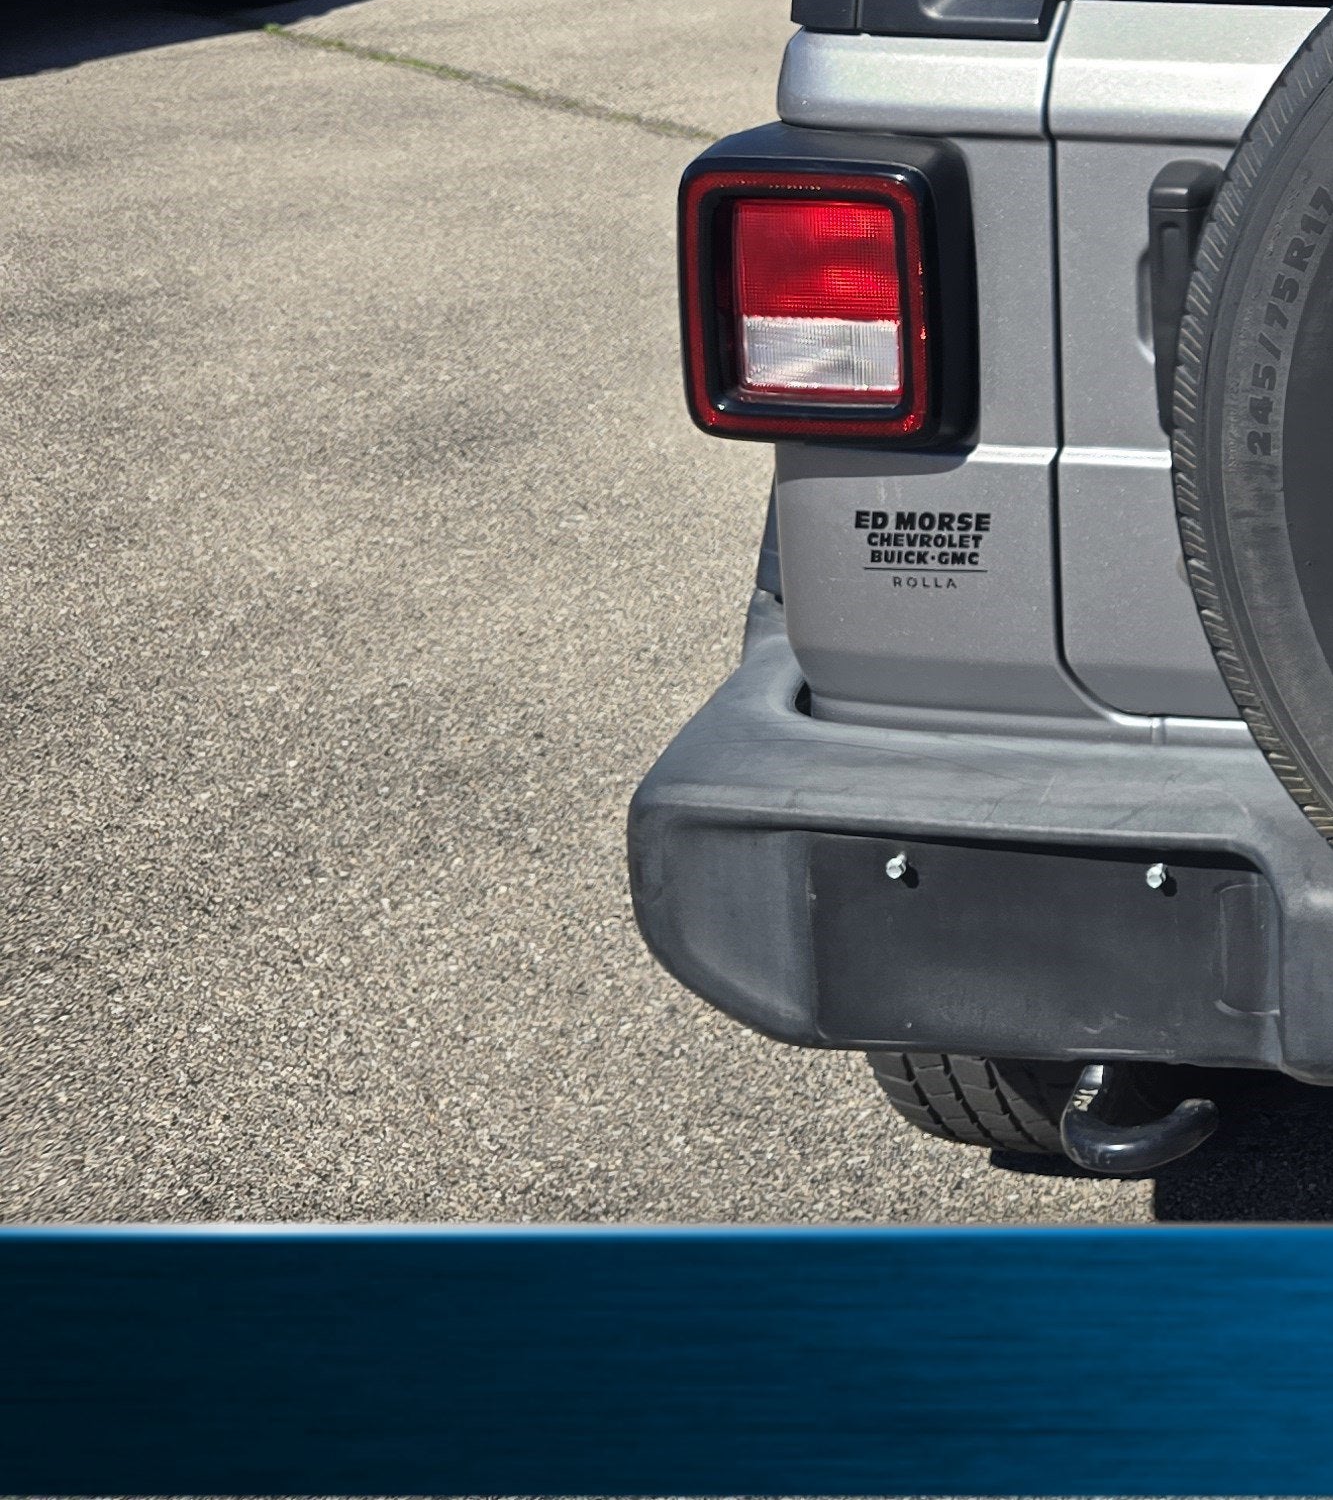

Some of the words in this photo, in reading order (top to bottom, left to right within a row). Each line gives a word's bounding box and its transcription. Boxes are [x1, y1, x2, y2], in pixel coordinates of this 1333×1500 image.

[854, 510, 889, 530] ED
[894, 511, 992, 532] MORSE
[866, 532, 984, 549] CHEVROLET
[892, 576, 958, 589] ROLLA
